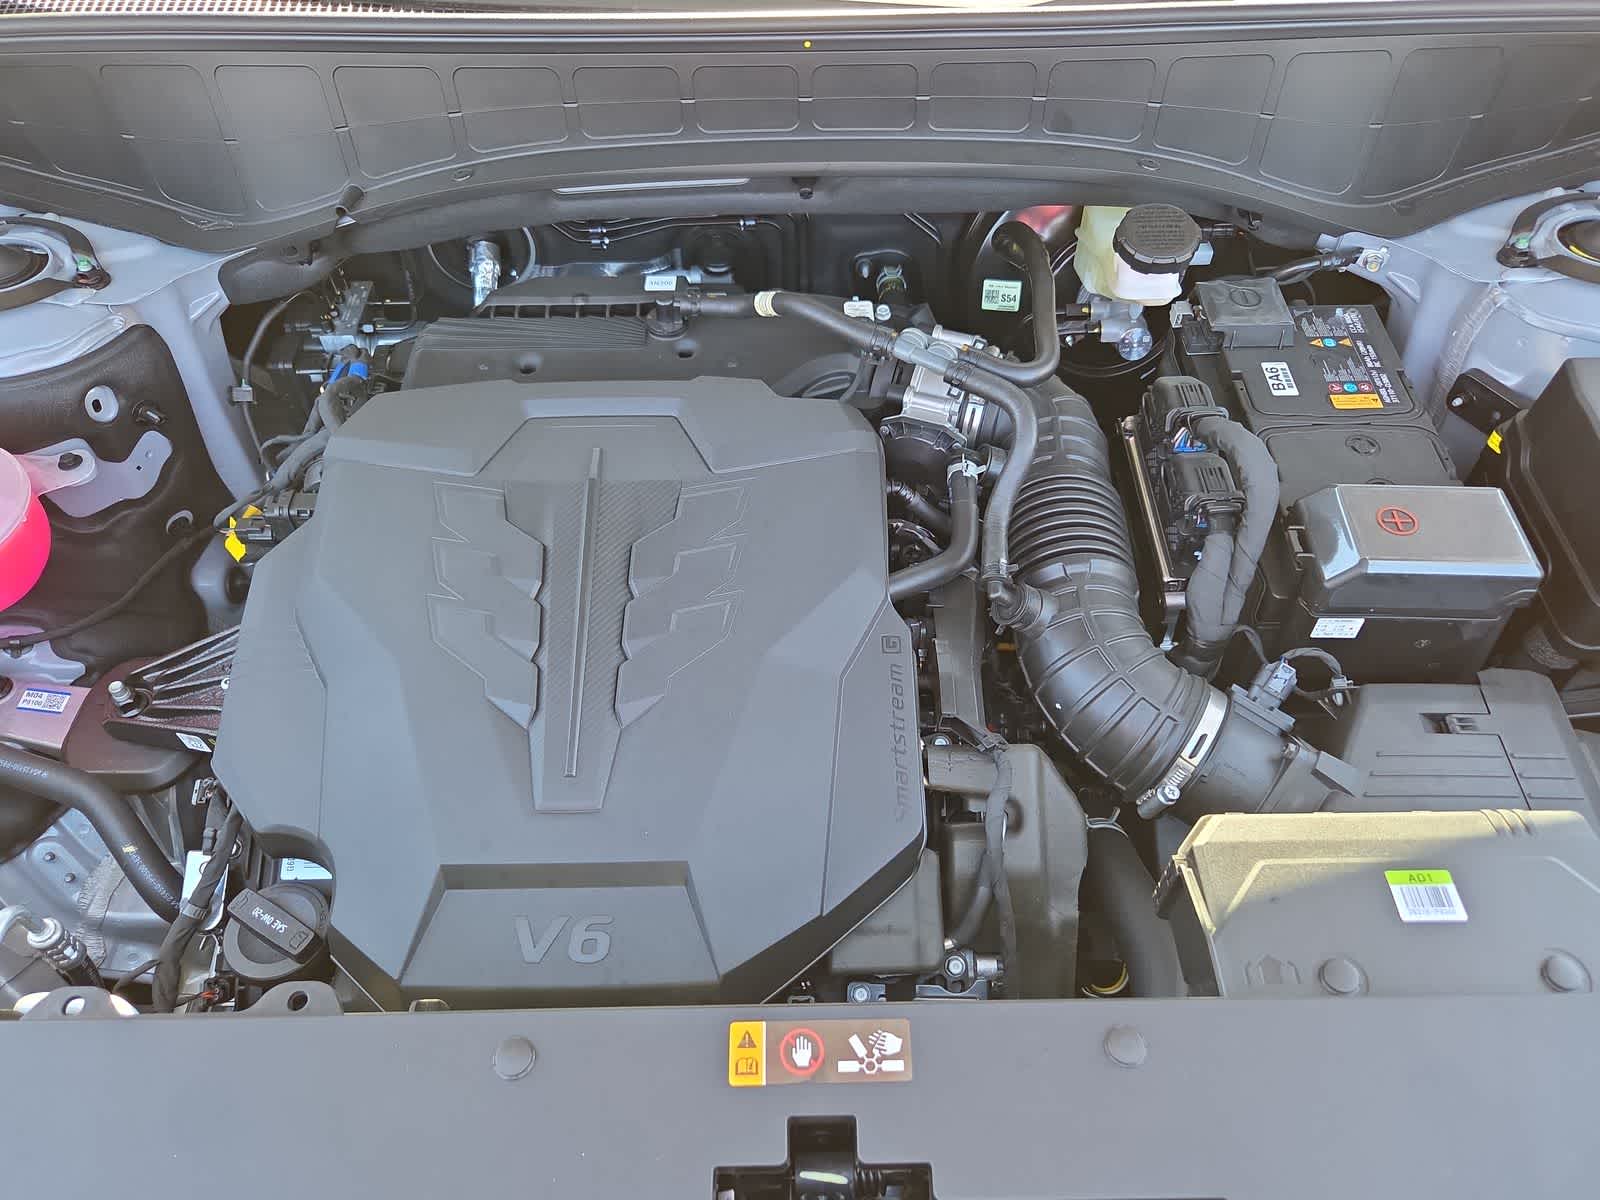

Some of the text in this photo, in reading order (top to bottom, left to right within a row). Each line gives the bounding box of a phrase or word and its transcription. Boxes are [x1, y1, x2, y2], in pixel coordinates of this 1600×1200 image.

[1001, 294, 1017, 303] S54
[1265, 366, 1286, 391] BA6
[1408, 873, 1433, 882] AD1
[271, 919, 288, 933] SAE
[515, 915, 615, 964] V6
